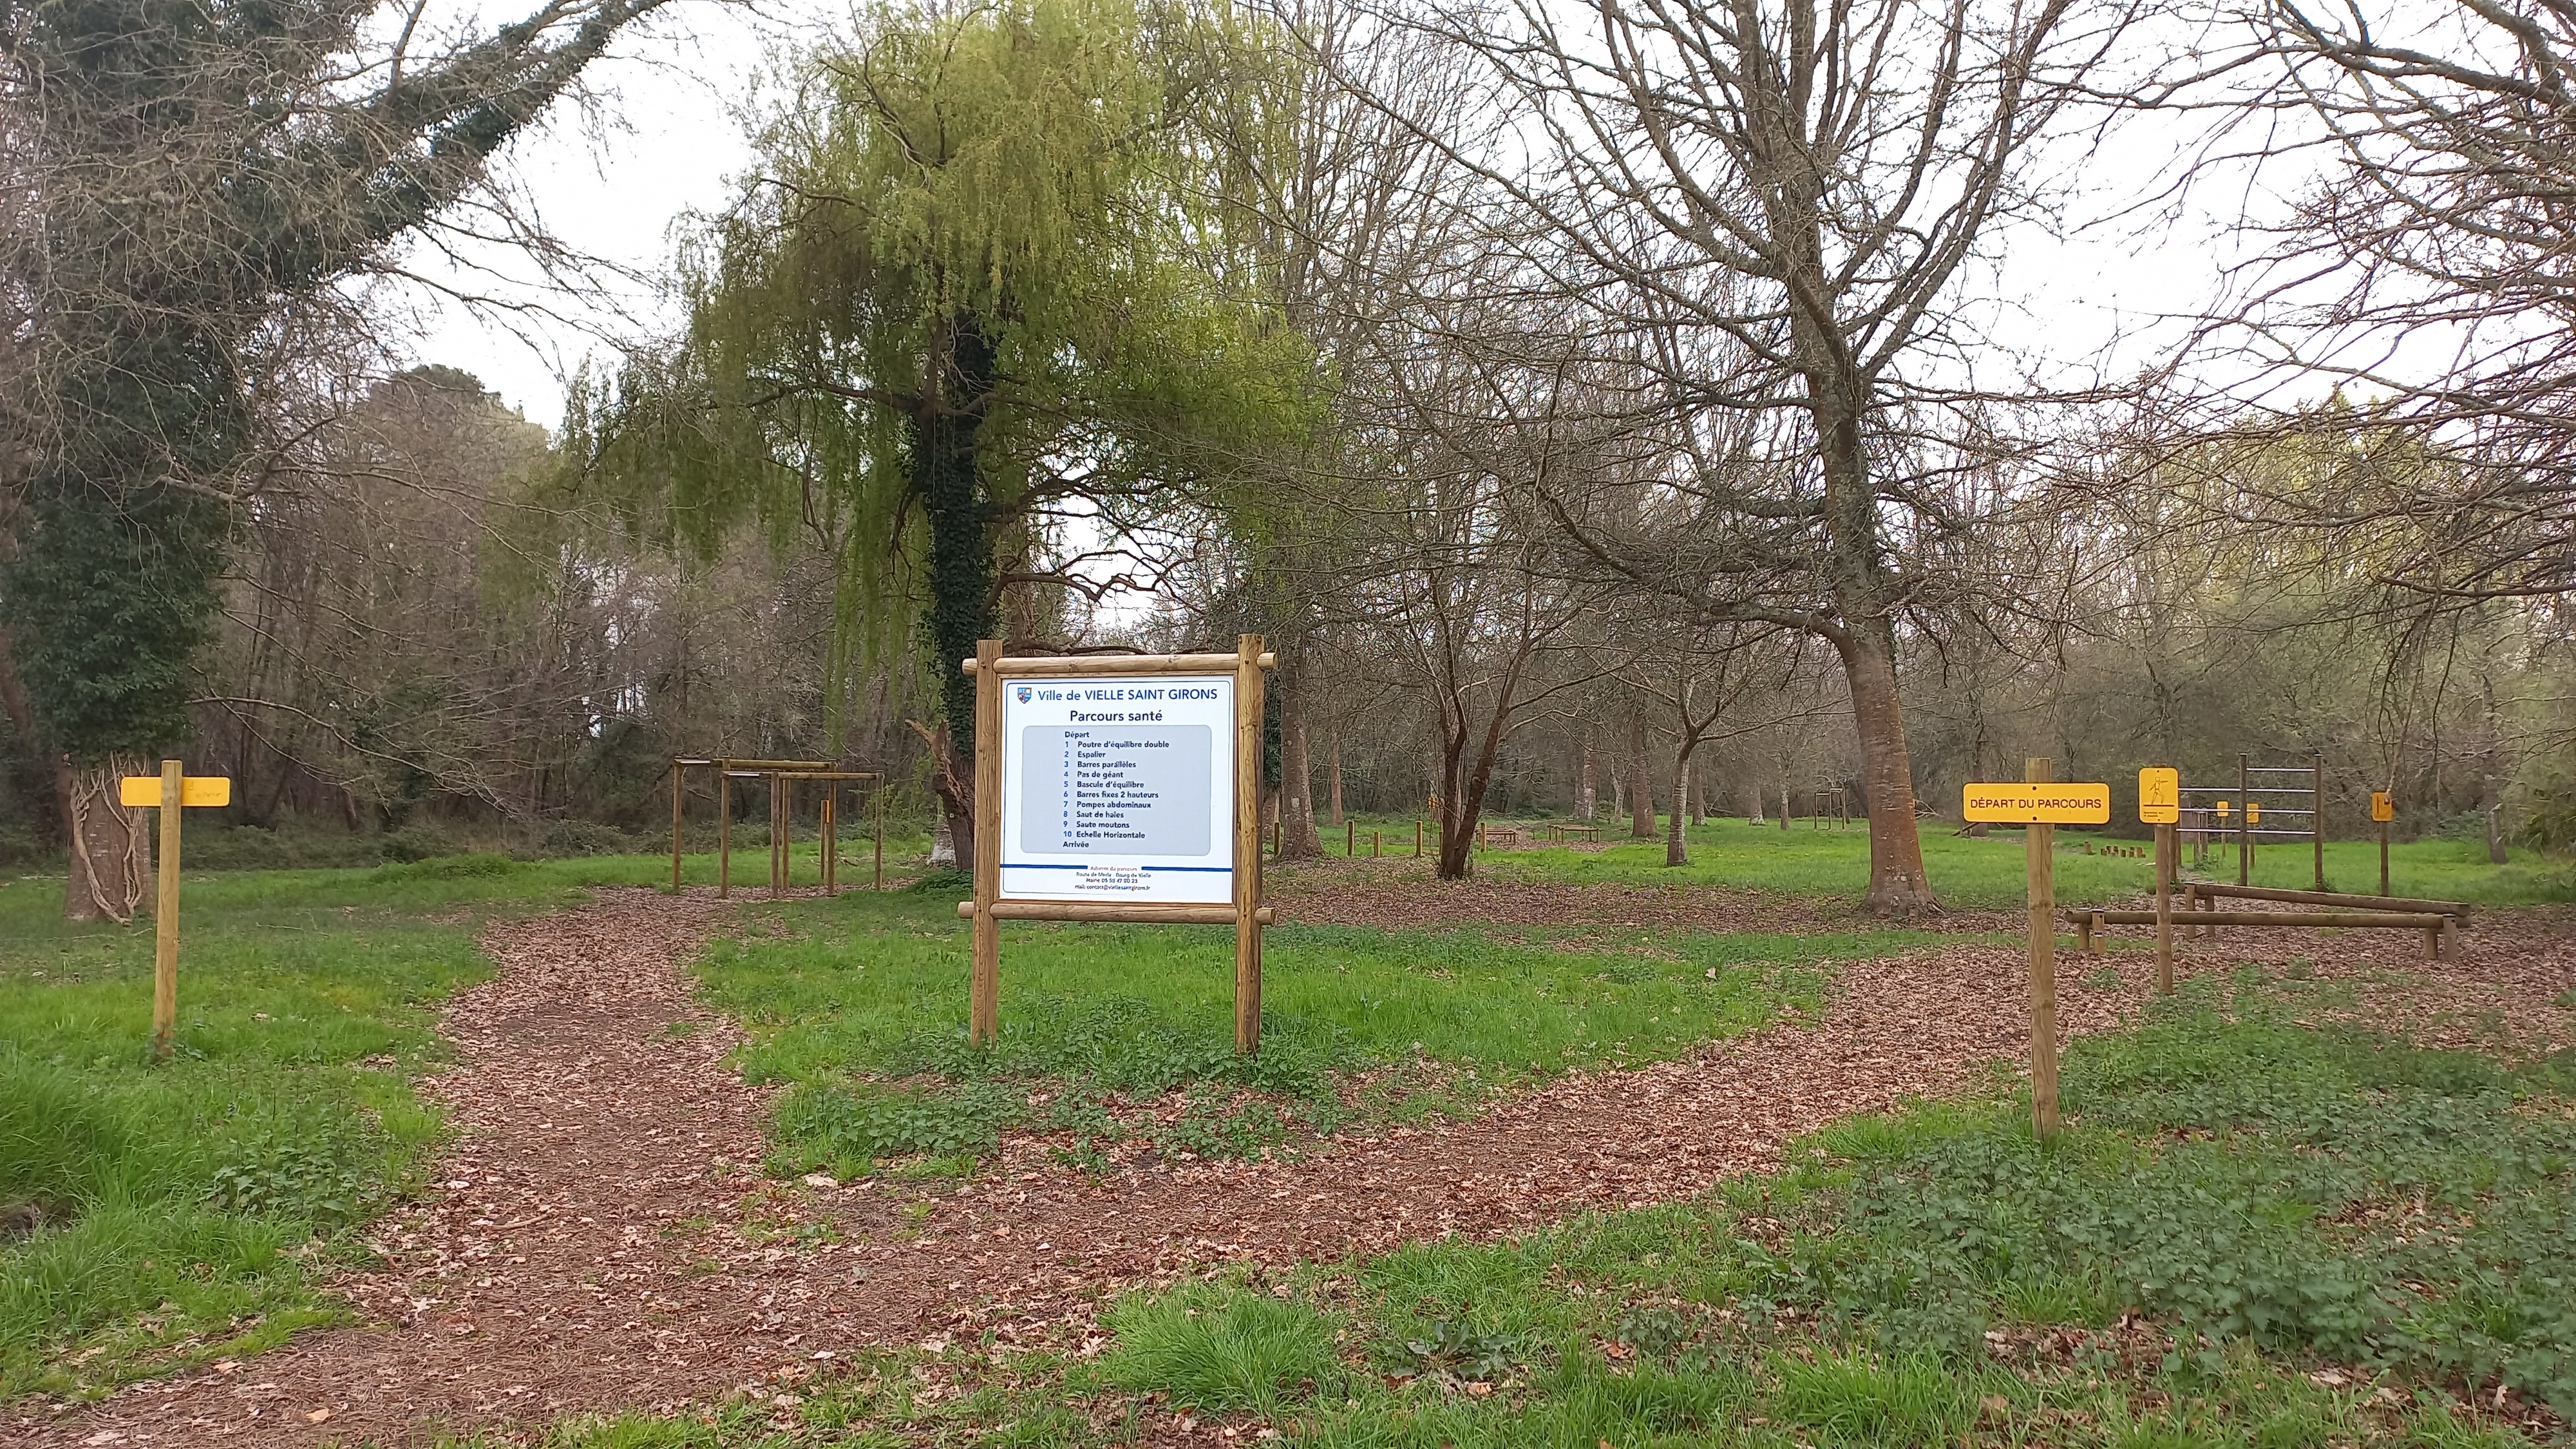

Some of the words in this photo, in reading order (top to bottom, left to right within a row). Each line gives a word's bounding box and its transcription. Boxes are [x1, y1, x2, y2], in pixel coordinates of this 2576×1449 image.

[1038, 690, 1062, 700] Ville
[1066, 690, 1081, 700] de
[1085, 690, 1123, 700] VIELLE
[1128, 689, 1165, 700] SAINT
[1168, 688, 1218, 699] GIRONS
[1070, 710, 1124, 721] Parcours
[1128, 710, 1162, 721] santé
[1065, 731, 1089, 739] Départ
[1104, 741, 1142, 749] d'équilibre
[1103, 771, 1123, 779] géant
[1971, 797, 2015, 808] DÉPART
[2019, 799, 2034, 808] DU
[2038, 799, 2101, 808] PARCOURS
